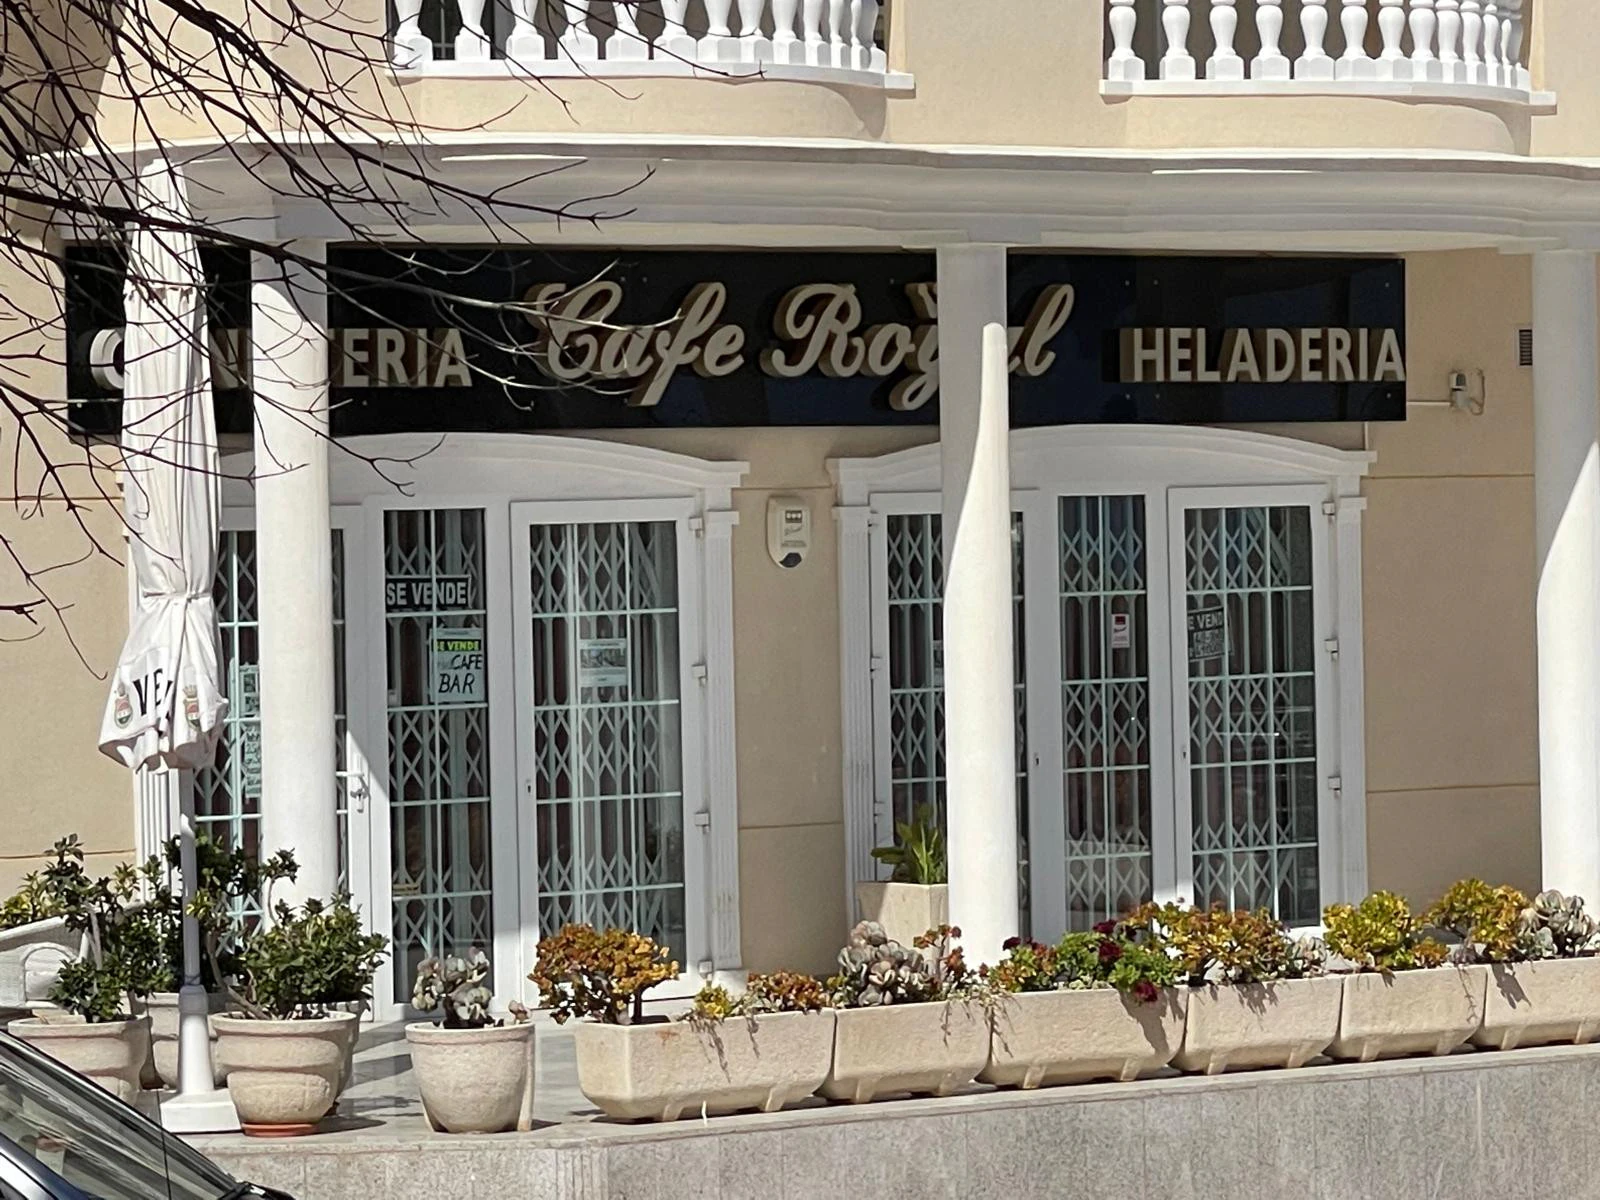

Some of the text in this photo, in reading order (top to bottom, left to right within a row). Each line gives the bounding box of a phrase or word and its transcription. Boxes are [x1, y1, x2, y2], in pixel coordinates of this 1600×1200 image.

[1120, 327, 1406, 382] HELADERIA
[386, 581, 468, 606] SE VENDE
[446, 640, 480, 651] VENDE
[450, 653, 483, 670] CAFE
[438, 672, 476, 694] BAR
